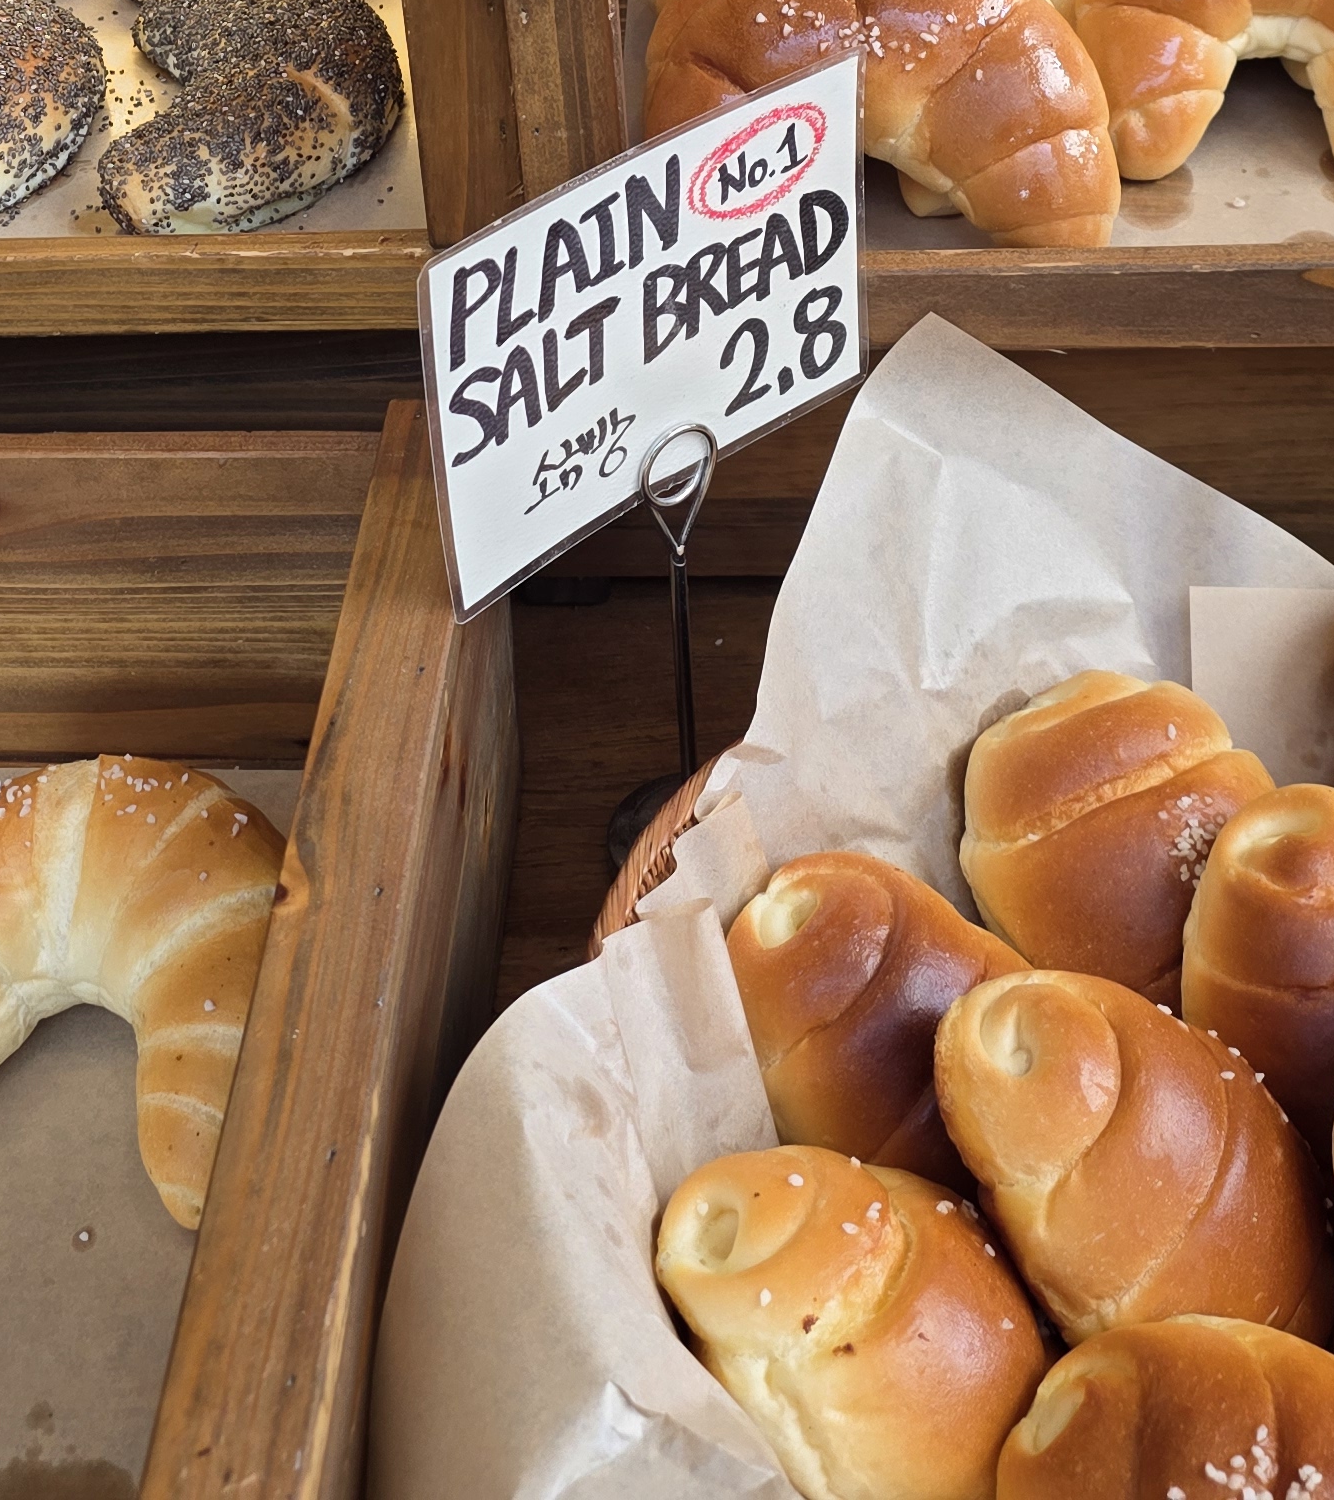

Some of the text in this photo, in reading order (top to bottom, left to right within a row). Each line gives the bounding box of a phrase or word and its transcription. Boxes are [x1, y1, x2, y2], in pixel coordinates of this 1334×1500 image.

[448, 188, 850, 469] SALT BREAD
[450, 121, 808, 373] PLAIN No.1
[719, 284, 848, 418] 2.8
[523, 406, 638, 516] 소금빵
